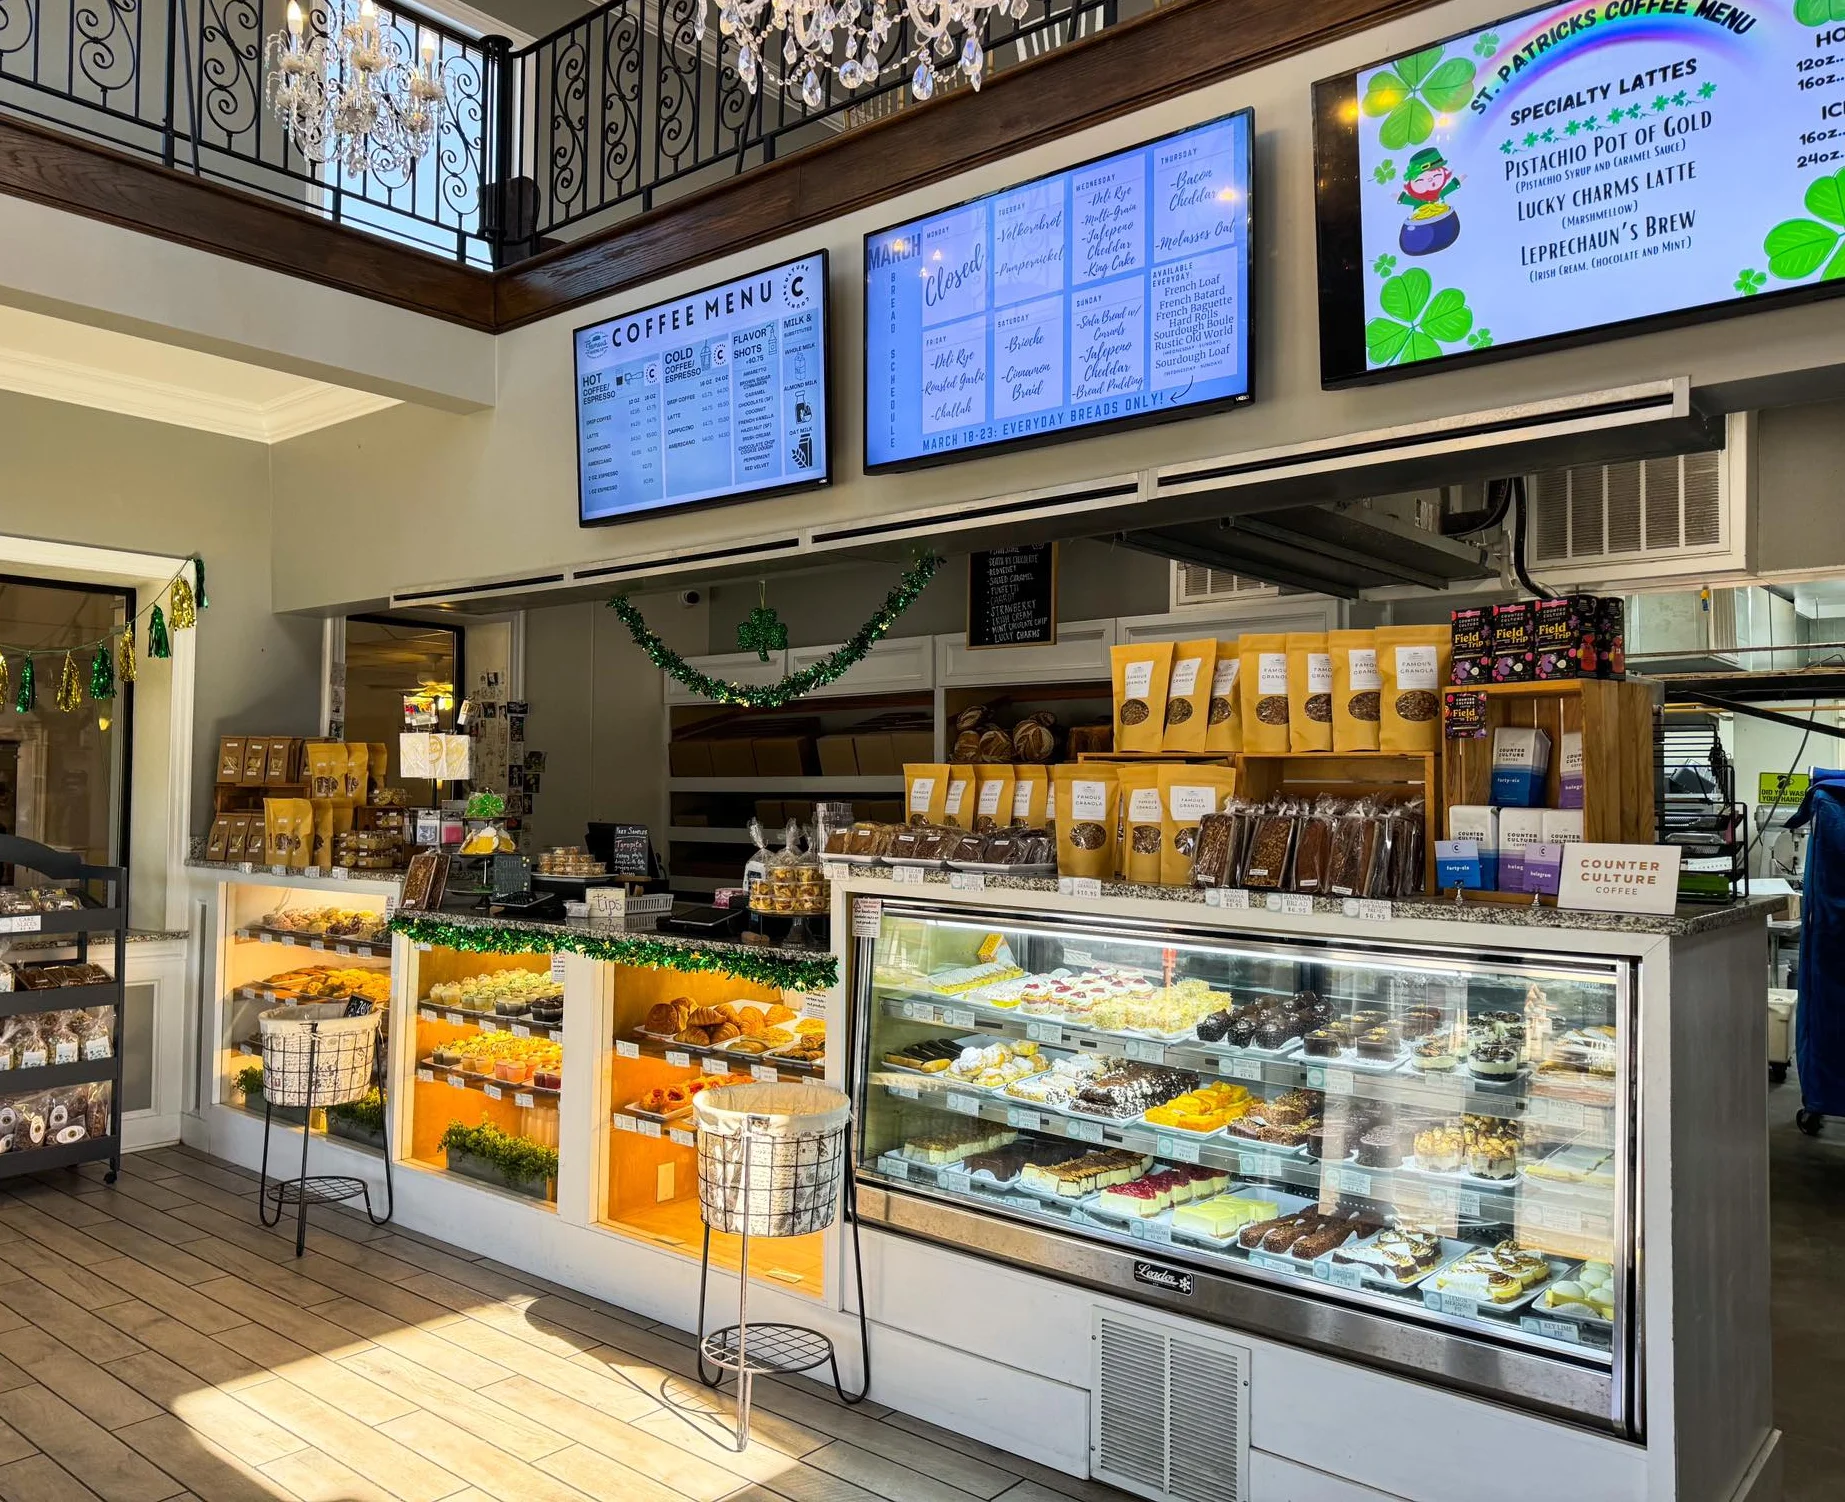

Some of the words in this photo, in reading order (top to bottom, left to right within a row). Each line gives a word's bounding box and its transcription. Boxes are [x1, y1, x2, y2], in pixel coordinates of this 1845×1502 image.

[1470, 86, 1500, 115] ST.
[1497, 8, 1597, 84] PATRICKS
[1604, 0, 1688, 21] COFFEE
[1693, 0, 1757, 35] MENU
[1510, 83, 1612, 126] SPECIALTY
[1619, 58, 1697, 95] LATTES
[1594, 132, 1628, 157] POT
[1635, 124, 1656, 146] OF
[1664, 110, 1712, 138] GOLD
[1161, 148, 1198, 165] THURSDAY
[1594, 152, 1611, 173] AND
[1076, 174, 1116, 191] WEDNESDAY
[1114, 186, 1132, 202] Rye
[1169, 186, 1218, 212] Cheddar
[1517, 194, 1566, 222] LUCKY
[1572, 175, 1639, 207] CHARMS
[1646, 161, 1697, 190] LATTE
[998, 203, 1026, 216] TUESDAY
[1646, 209, 1696, 238] BREW
[926, 227, 949, 239] MONDAY
[867, 233, 921, 271] MARCH
[1087, 239, 1132, 260] Cheddar
[1642, 245, 1659, 257] AND
[1111, 252, 1137, 271] Cake
[925, 243, 985, 307] Closed
[1152, 262, 1193, 279] AVAILABLE
[791, 276, 804, 297] C
[1152, 272, 1191, 288] EVERYDAY
[1164, 281, 1197, 297] French
[1199, 273, 1221, 288] Loaf
[1076, 295, 1102, 308] SUNDAY
[1159, 294, 1192, 310] French
[1193, 286, 1226, 301] Batard
[612, 304, 694, 347] COFFEE
[705, 280, 772, 320] MENU
[1101, 306, 1127, 325] Bread
[1128, 304, 1142, 318] w/
[1156, 305, 1188, 321] French
[1190, 296, 1233, 314] Baguette
[783, 315, 804, 329] MILK
[805, 313, 812, 322] &
[997, 314, 1030, 328] SATURDAY
[1169, 315, 1192, 328] Hard
[1195, 309, 1218, 321] Rolls
[1153, 321, 1205, 341] Sourdough
[1207, 314, 1234, 329] Boule
[733, 328, 767, 345] FLAVOR
[926, 336, 947, 346] FRIDAY
[1155, 337, 1184, 351] Rustic
[1185, 330, 1202, 343] Old
[1203, 325, 1233, 340] World
[664, 347, 693, 365] COLD
[733, 343, 762, 359] SHOTS
[785, 346, 802, 355] WHOLE
[803, 342, 816, 351] MILK
[1155, 350, 1206, 370] Sourdough
[1208, 344, 1231, 357] Loaf
[956, 348, 974, 368] Rye
[665, 360, 695, 374] COFFEE/
[665, 367, 702, 384] ESPRESSO
[1084, 359, 1131, 382] Cheddar
[582, 373, 602, 387] HOT
[783, 383, 804, 391] ALMOND
[804, 380, 818, 388] MILK
[959, 368, 986, 391] Garlic
[1106, 375, 1143, 393] Pudding
[583, 383, 610, 397] COFFEE/
[583, 390, 616, 405] ESPRESSO
[1012, 380, 1044, 402] Braid
[922, 433, 958, 452] MARCH
[963, 427, 997, 443] 18-23:
[1003, 412, 1065, 436] EVERYDAY
[1070, 402, 1118, 422] BREADS
[1125, 392, 1164, 411] ONLY!
[788, 428, 800, 436] OAT
[800, 426, 812, 434] MILK
[1496, 626, 1524, 638] Field
[1538, 621, 1567, 635] Field
[1553, 631, 1572, 640] Trip
[1454, 631, 1480, 644] Field
[1511, 636, 1529, 644] Trip
[1453, 708, 1475, 717] Field
[1581, 859, 1660, 871] COUNTER
[1581, 872, 1657, 884] CULTURE
[1595, 886, 1638, 895] COFFEE
